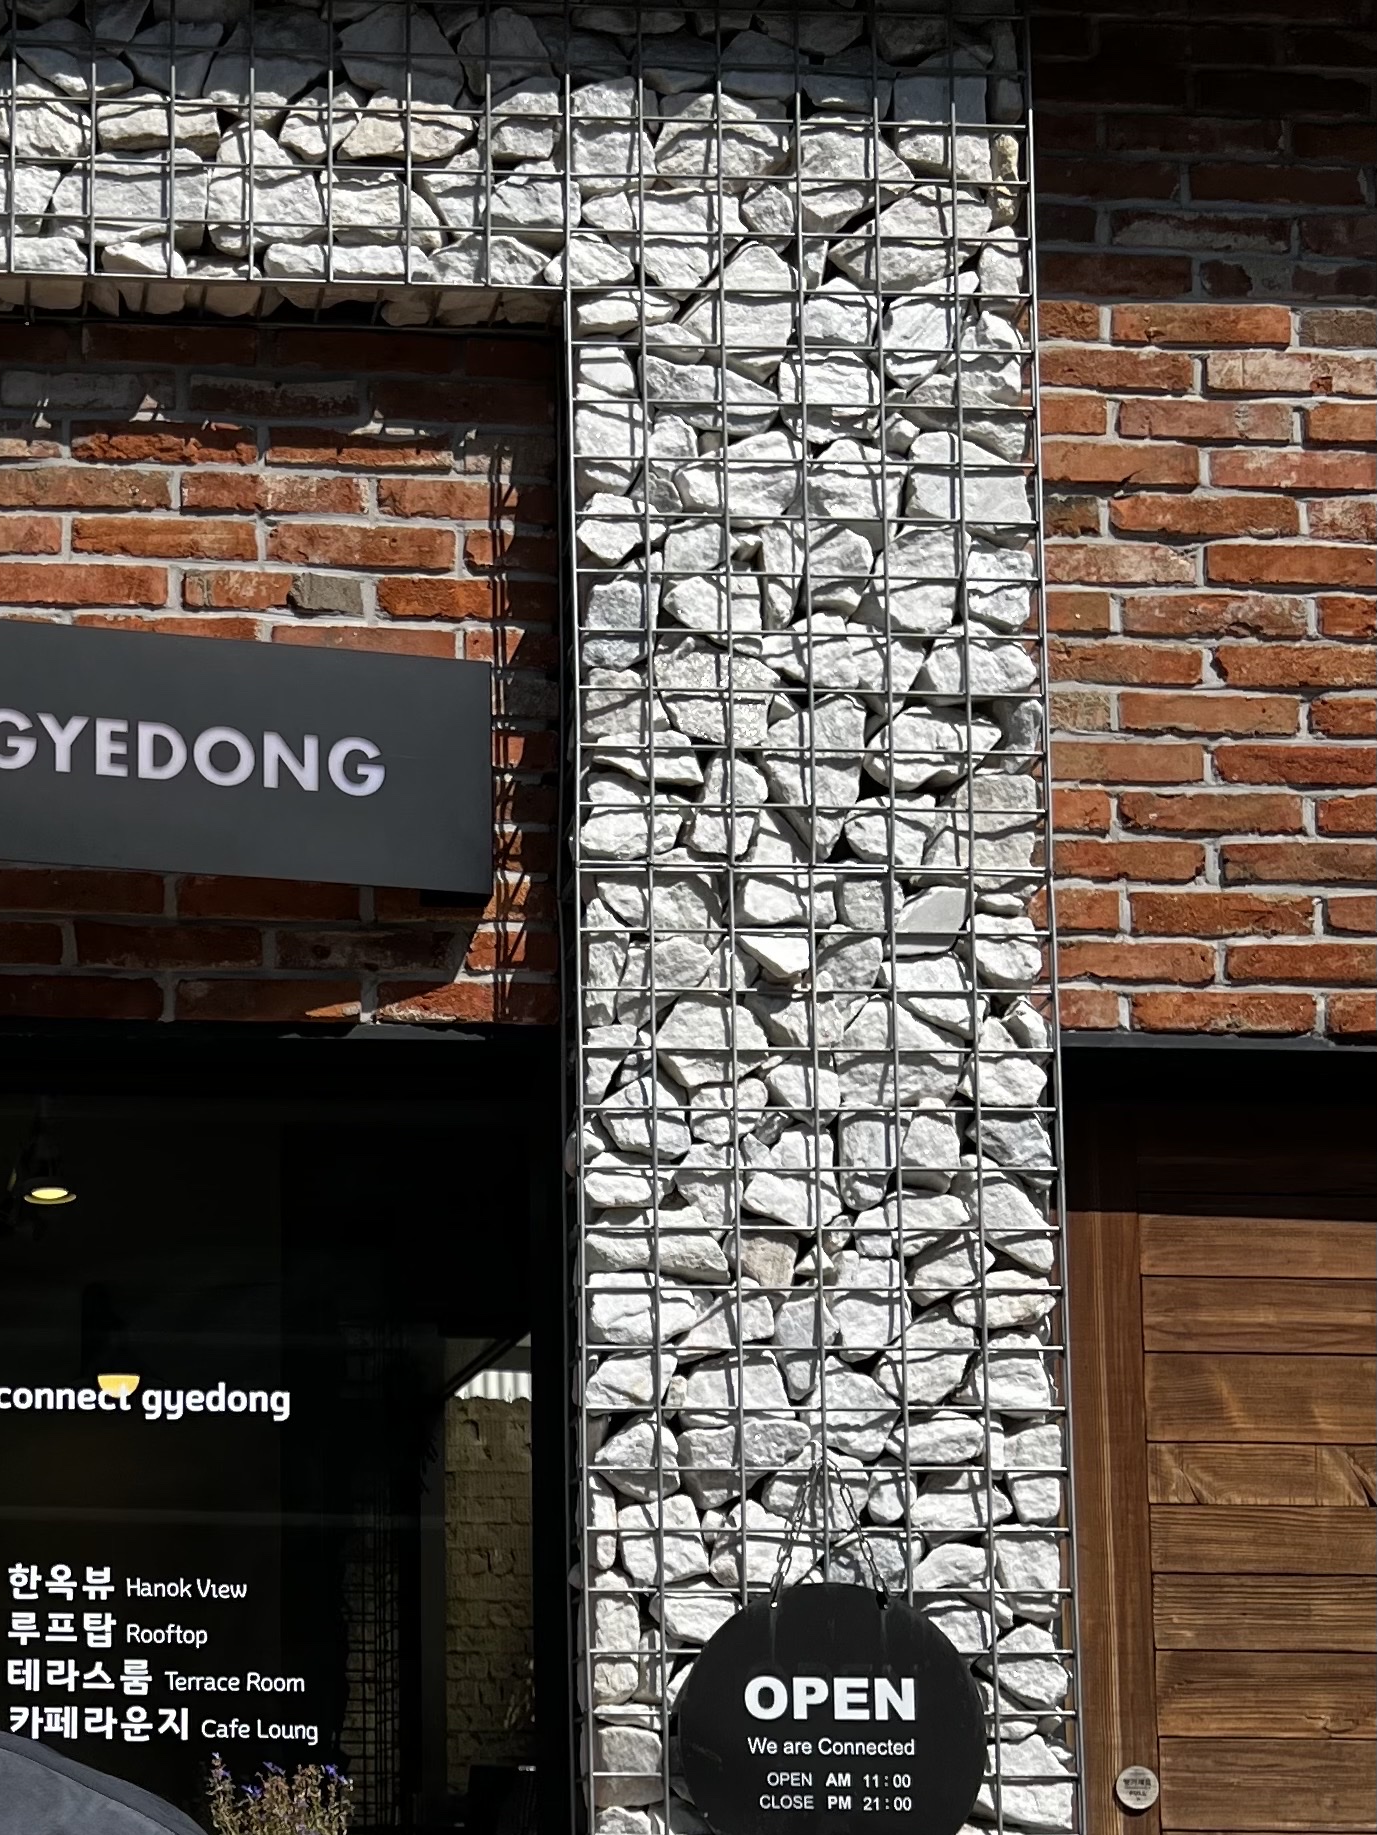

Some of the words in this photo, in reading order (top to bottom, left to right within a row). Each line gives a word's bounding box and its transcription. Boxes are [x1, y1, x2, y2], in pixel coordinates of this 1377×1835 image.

[142, 1382, 292, 1422] gyedong
[7, 1562, 115, 1601] 한옥뷰
[126, 1576, 194, 1599] Hanok
[196, 1576, 248, 1599] View
[7, 1611, 117, 1648] 루프탑
[126, 1622, 209, 1650] Rooftop
[7, 1658, 153, 1696] 테라스룸
[164, 1671, 243, 1693] Terrace
[247, 1671, 306, 1693] Room
[744, 1675, 916, 1721] OPEN
[9, 1705, 189, 1742] 카페라운지
[201, 1717, 252, 1741] Cafe
[257, 1717, 319, 1746] Loung
[747, 1736, 778, 1755] We
[783, 1741, 813, 1755] are
[817, 1737, 915, 1756] Connected
[766, 1771, 813, 1787] OPEN
[825, 1772, 852, 1787] AM
[759, 1794, 815, 1810] CLOSE
[827, 1795, 852, 1810] PM
